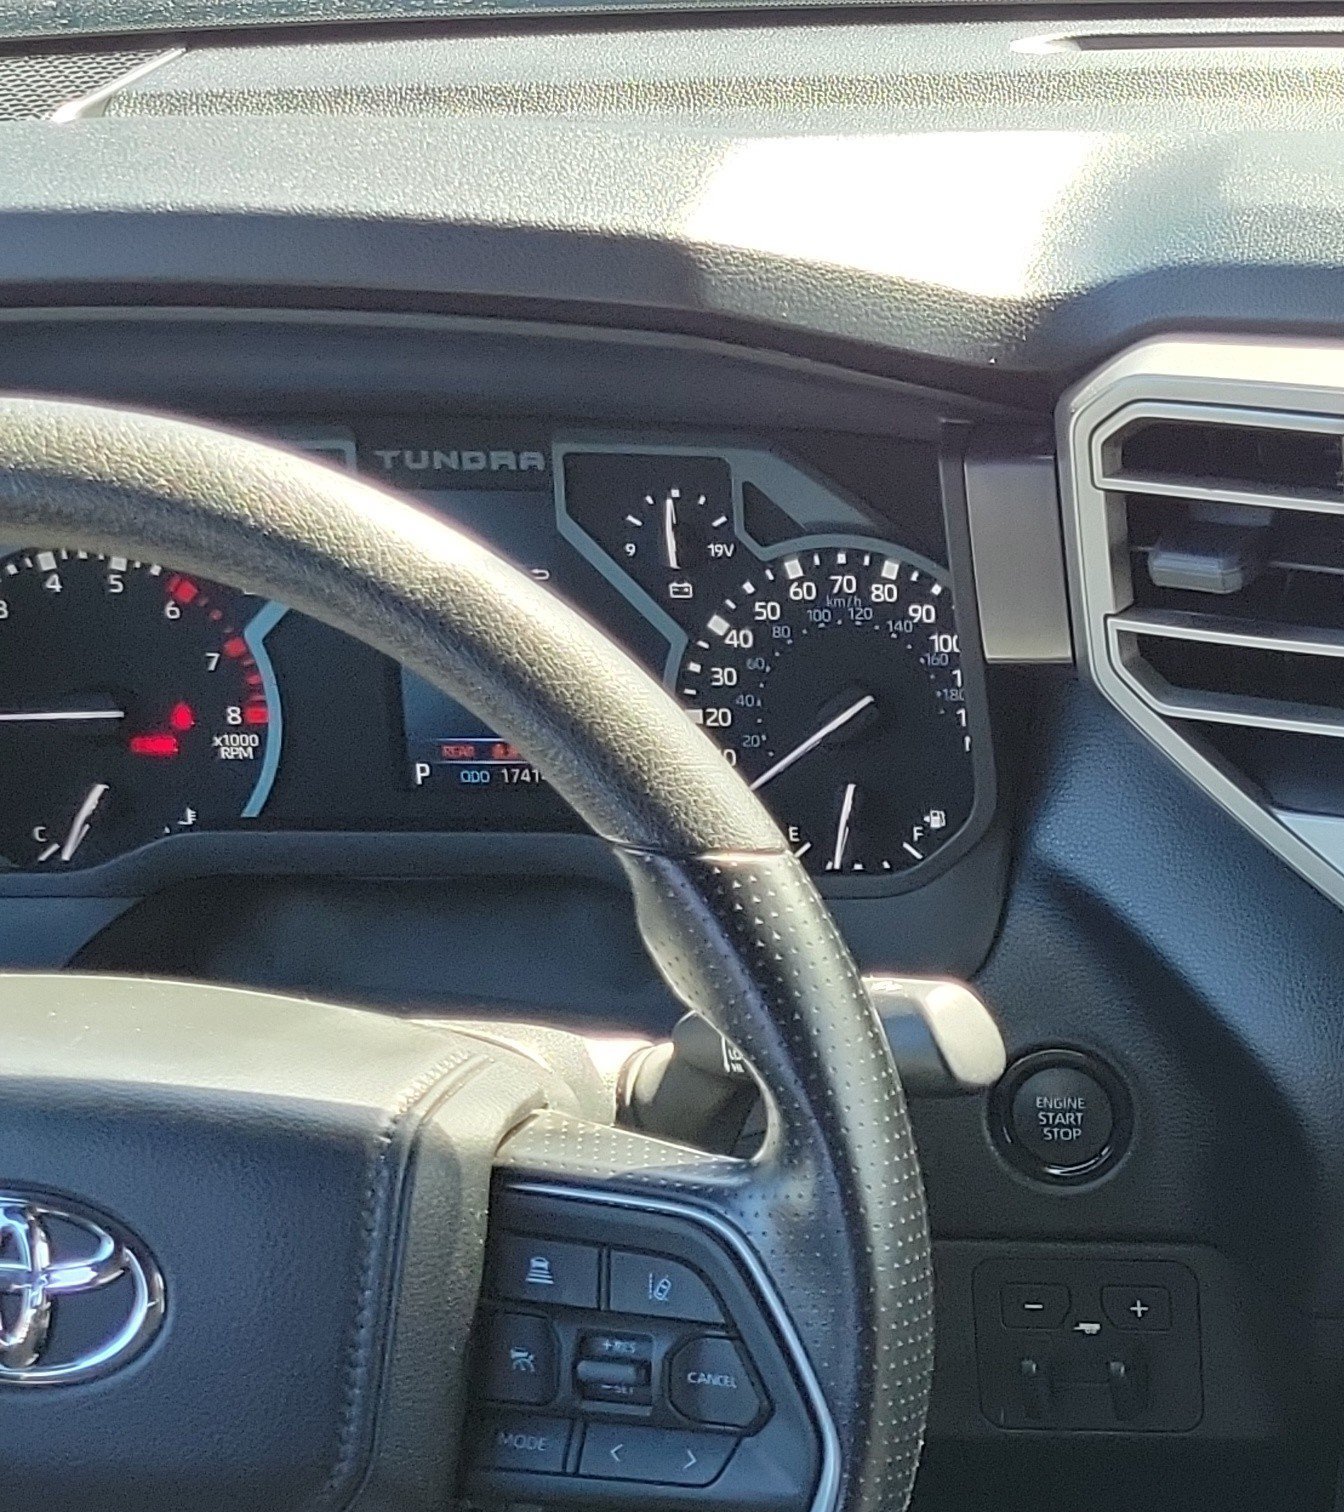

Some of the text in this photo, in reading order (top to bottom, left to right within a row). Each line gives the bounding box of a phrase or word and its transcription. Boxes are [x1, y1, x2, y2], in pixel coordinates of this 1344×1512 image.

[374, 450, 546, 470] TUNDRA
[625, 543, 636, 557] 9
[707, 543, 735, 557] 19V
[45, 573, 62, 593] 4
[108, 574, 124, 593] 5
[789, 581, 817, 600] 60
[829, 575, 857, 594] 70
[871, 583, 898, 602] 80
[165, 600, 180, 619] 6
[826, 595, 862, 608] km/h
[754, 602, 780, 620] 50
[806, 609, 832, 622] 100
[848, 607, 873, 620] 120
[908, 604, 936, 623] 90
[772, 625, 791, 638] 80
[887, 620, 913, 633] 140
[724, 630, 753, 648] 40
[205, 652, 221, 671] 7
[925, 653, 949, 666] 160
[711, 667, 738, 686] 30
[736, 694, 755, 707] 40
[226, 706, 242, 725] 8
[706, 708, 732, 727] 20
[212, 734, 260, 747] x1000
[743, 734, 761, 748] 20
[219, 747, 254, 760] RPM
[415, 763, 431, 785] P
[460, 770, 490, 783] ODO
[34, 826, 47, 842] C
[788, 826, 800, 842] E
[913, 826, 924, 842] F
[1036, 1096, 1086, 1109] ENGINE
[1038, 1111, 1083, 1125] START
[1043, 1127, 1082, 1140] STOP
[687, 1371, 737, 1389] CANCEL
[500, 1432, 549, 1451] MODE
